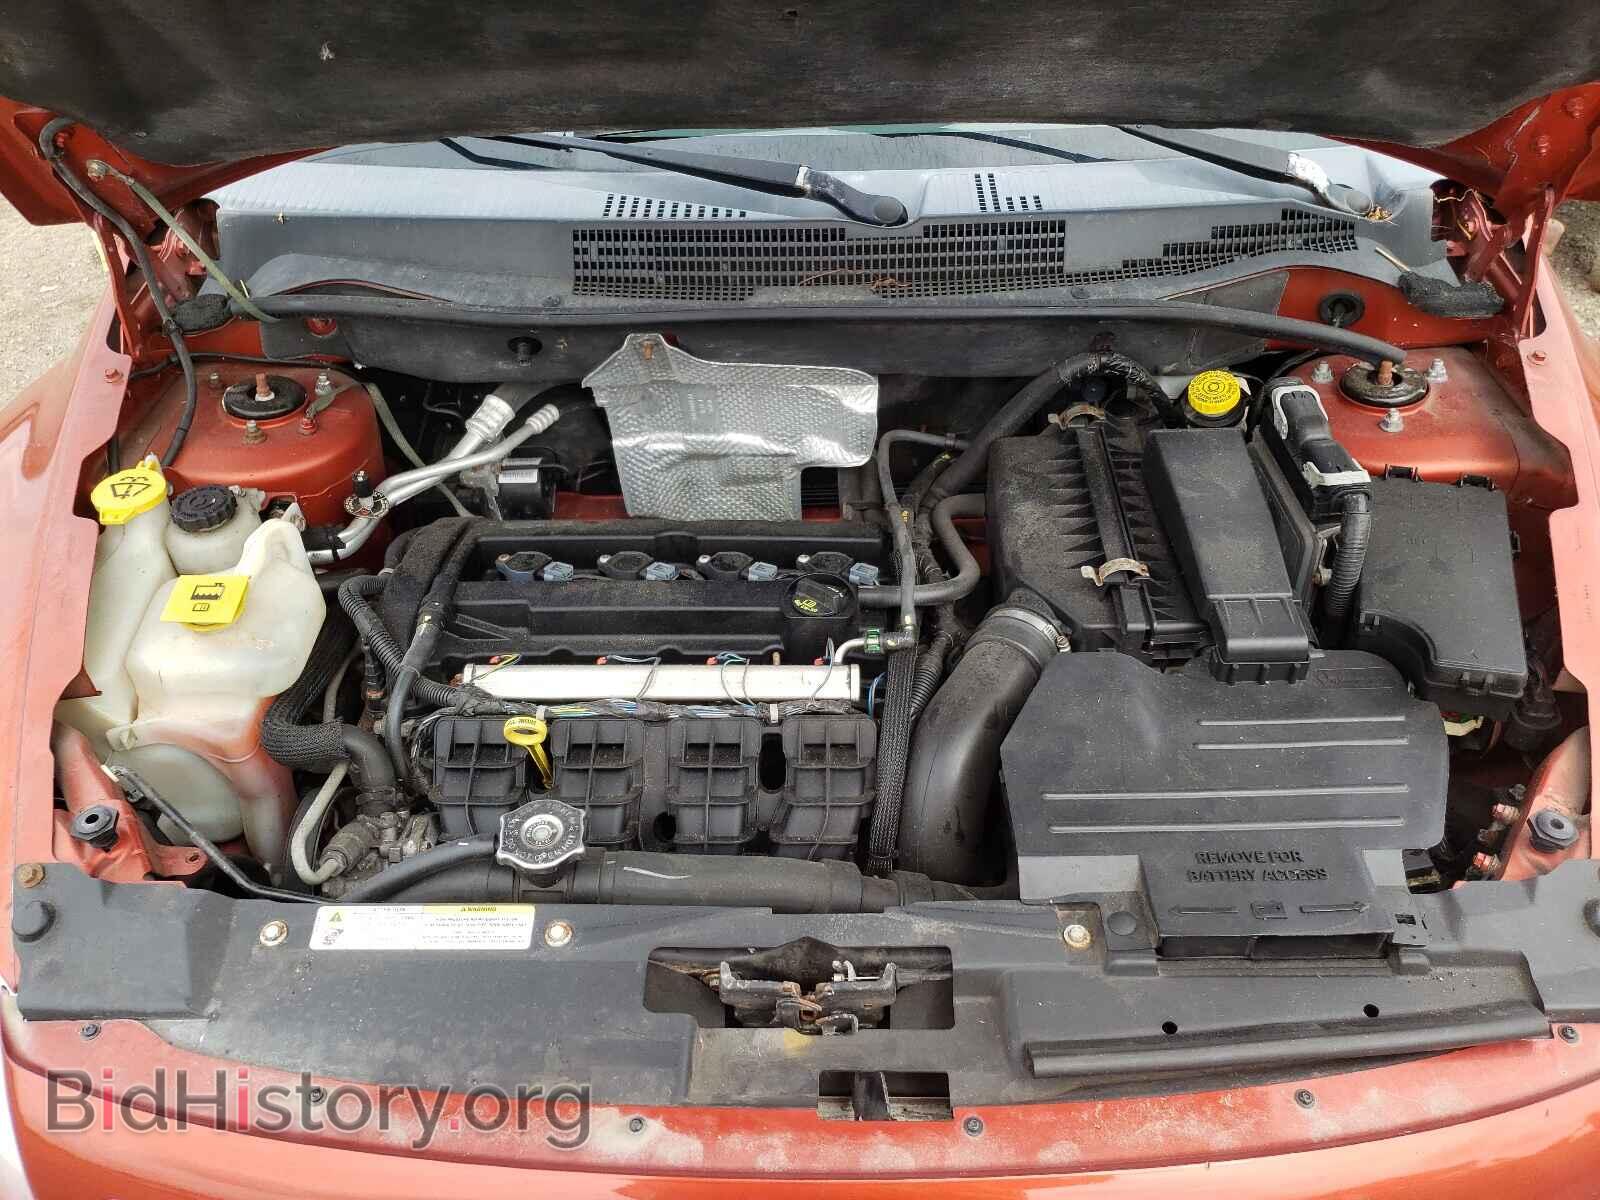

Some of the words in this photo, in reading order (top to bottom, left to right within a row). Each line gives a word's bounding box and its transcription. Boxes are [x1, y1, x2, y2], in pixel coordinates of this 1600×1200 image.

[1195, 850, 1266, 865] REMOVE
[1268, 850, 1304, 865] FOR
[1187, 869, 1257, 883] BATTERY
[1263, 868, 1329, 882] ACCESS
